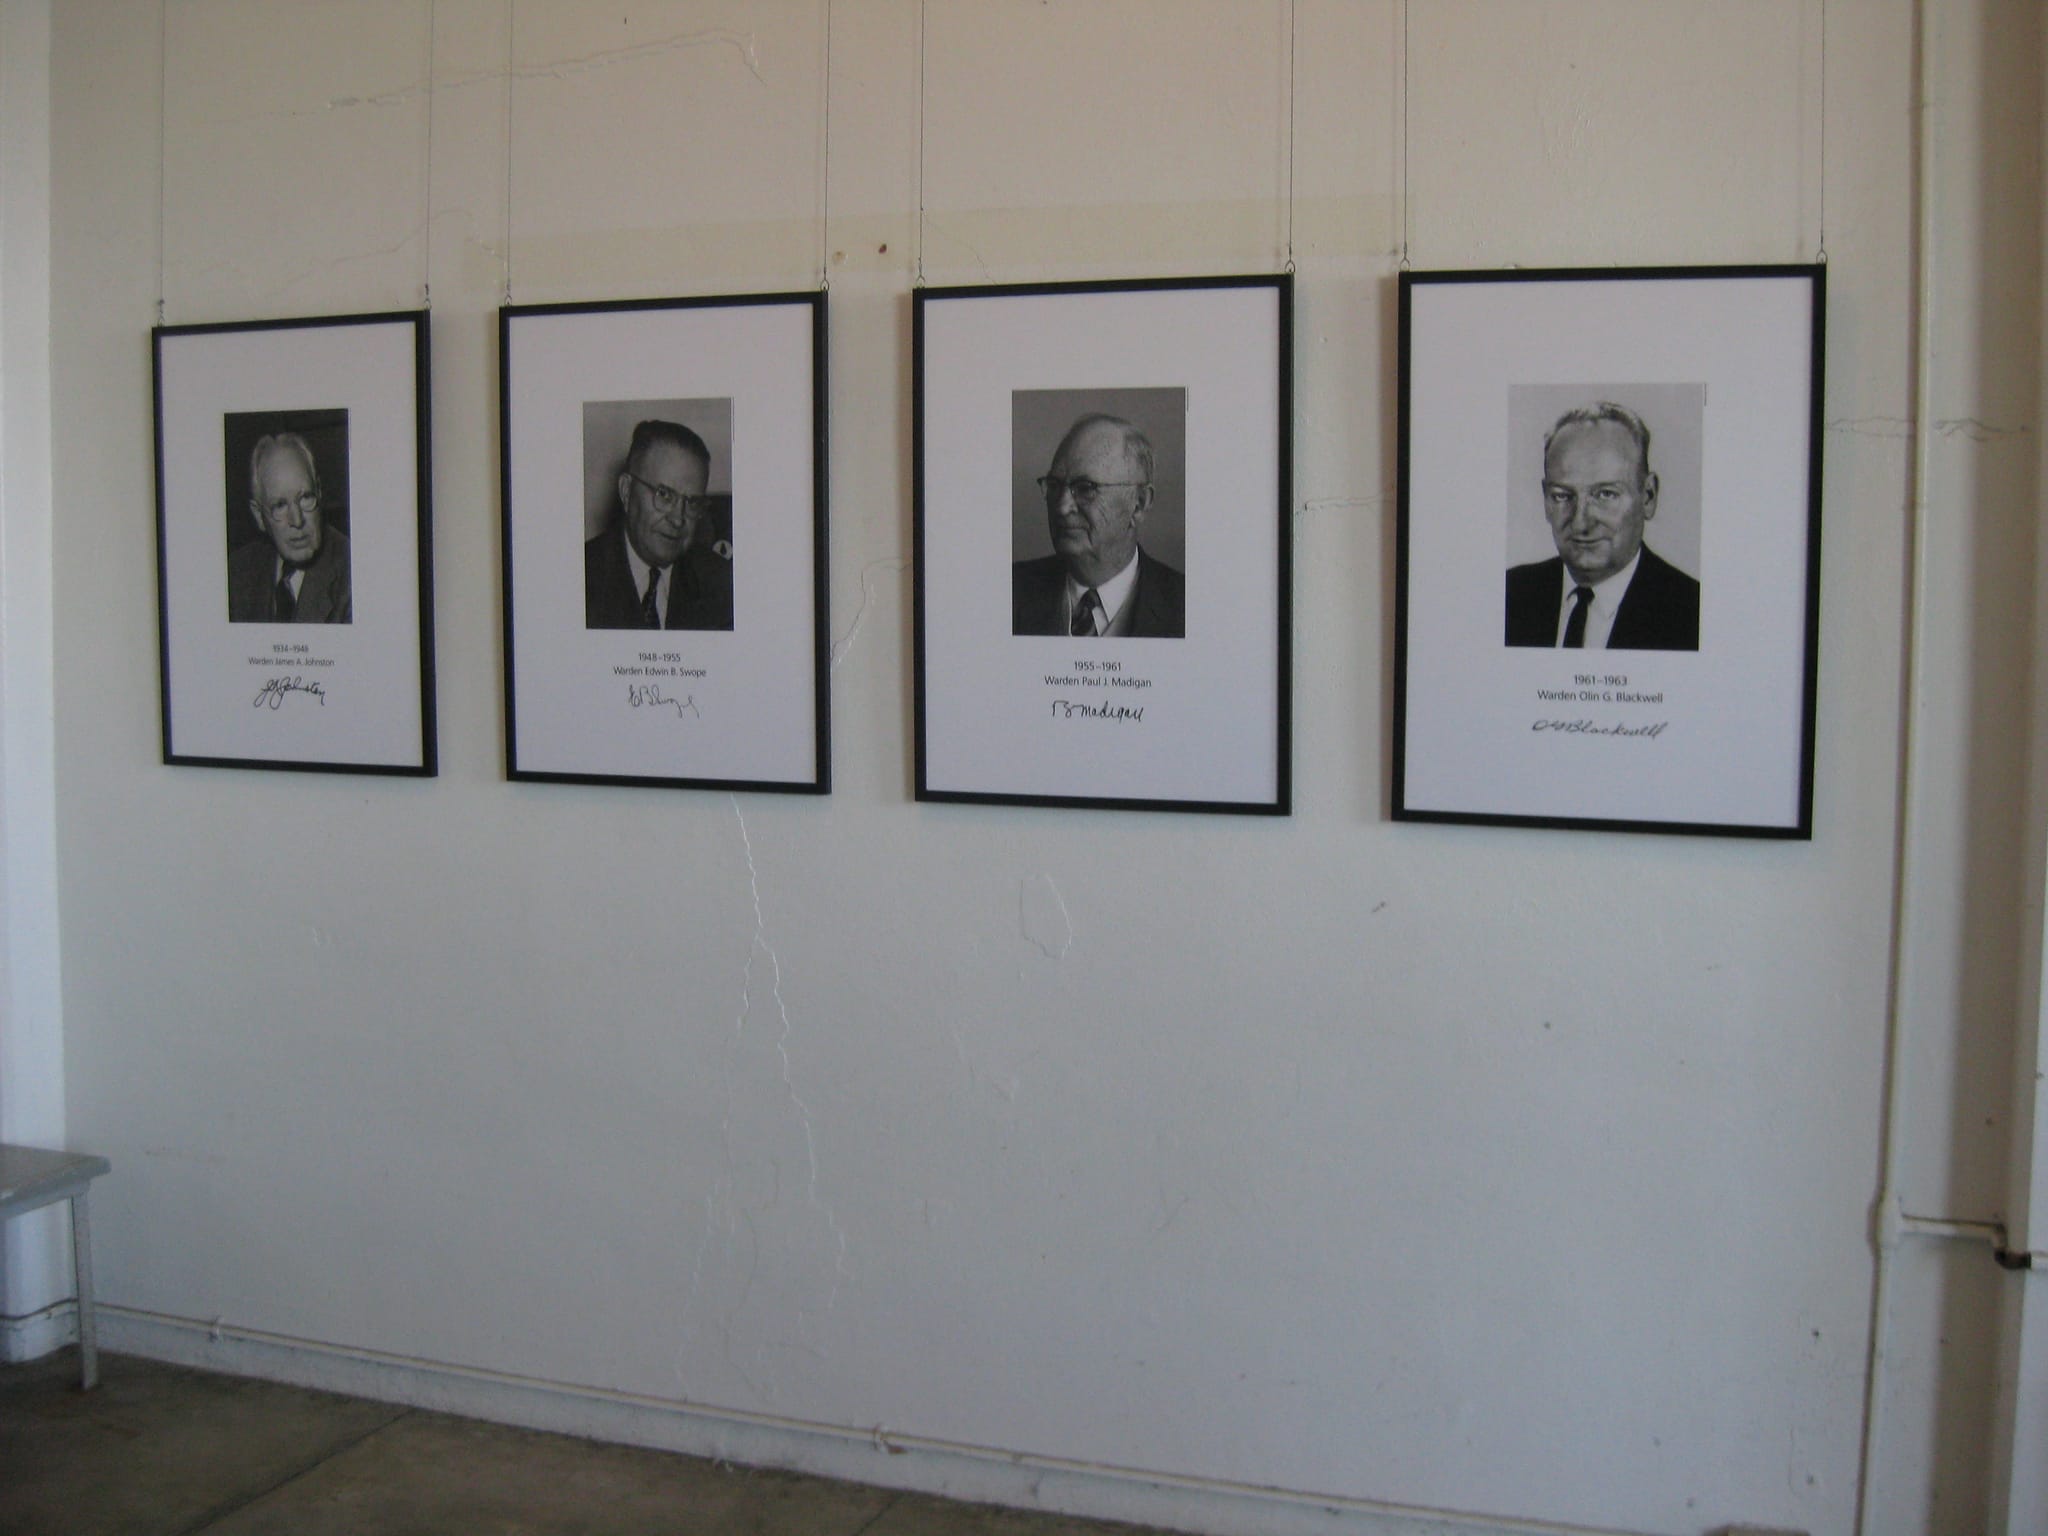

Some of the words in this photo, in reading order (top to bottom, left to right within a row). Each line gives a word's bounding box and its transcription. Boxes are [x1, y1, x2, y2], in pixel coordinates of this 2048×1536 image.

[248, 656, 274, 666] Warden
[304, 657, 335, 667] Johnston
[613, 665, 643, 676] Warden
[645, 666, 669, 677] Edwin
[679, 667, 707, 679] Swope
[1044, 675, 1080, 686] Warden
[1082, 676, 1101, 687] Paul
[1111, 677, 1152, 690] Madigan
[1536, 689, 1577, 702] Warden
[1579, 690, 1600, 702] Olin
[1602, 691, 1613, 703] G.
[1615, 691, 1664, 704] Blackwell
